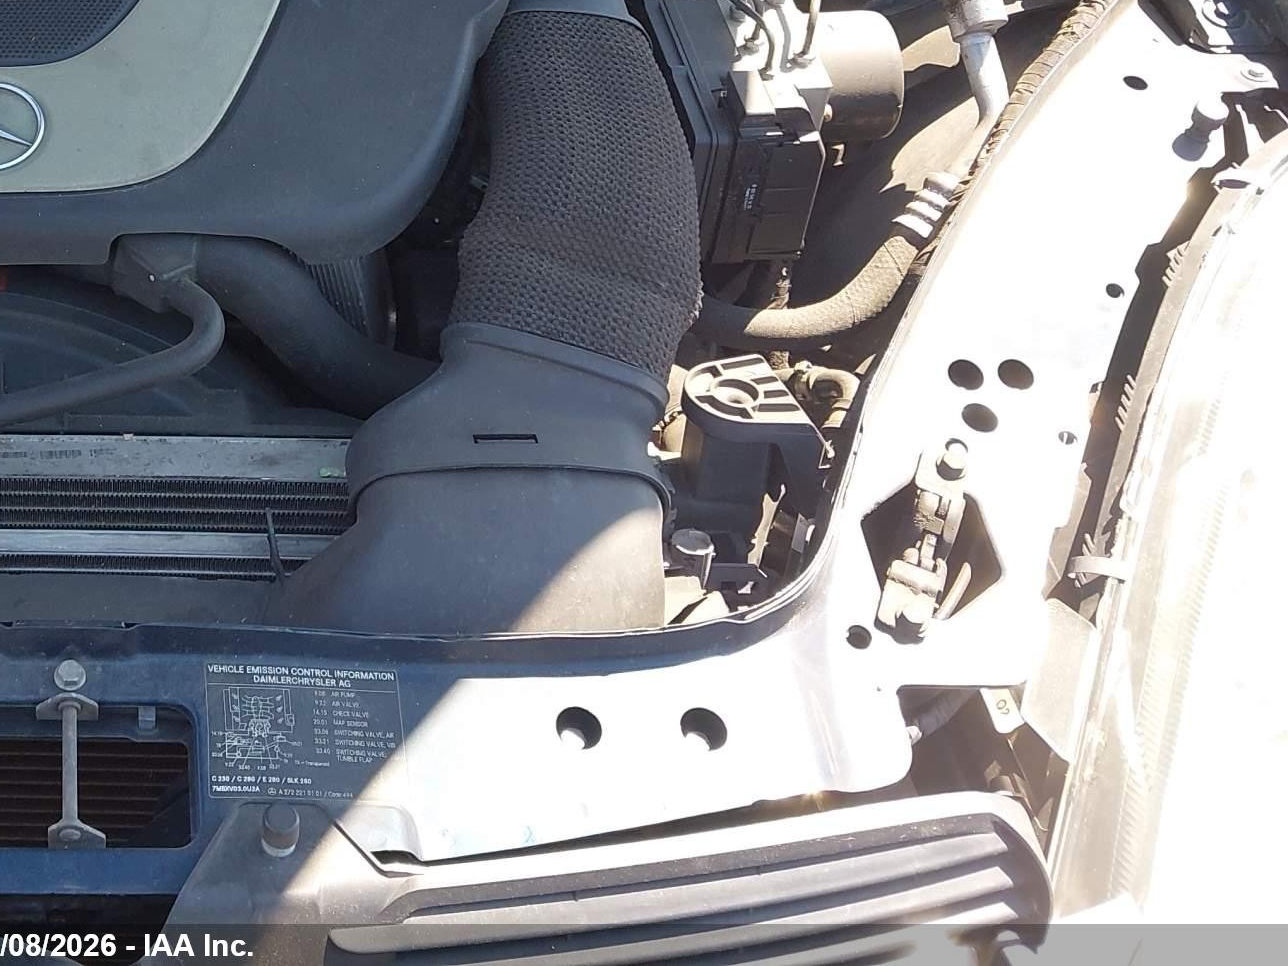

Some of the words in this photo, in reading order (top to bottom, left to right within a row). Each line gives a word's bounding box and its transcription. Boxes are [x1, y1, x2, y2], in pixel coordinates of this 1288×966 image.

[208, 665, 244, 674] VEHICLE
[246, 666, 289, 675] EMISSION
[291, 668, 332, 677] CONTROL
[334, 670, 394, 680] INFORMATION
[253, 675, 337, 686] DAIMLERCHRYSLER
[338, 679, 351, 688] AG
